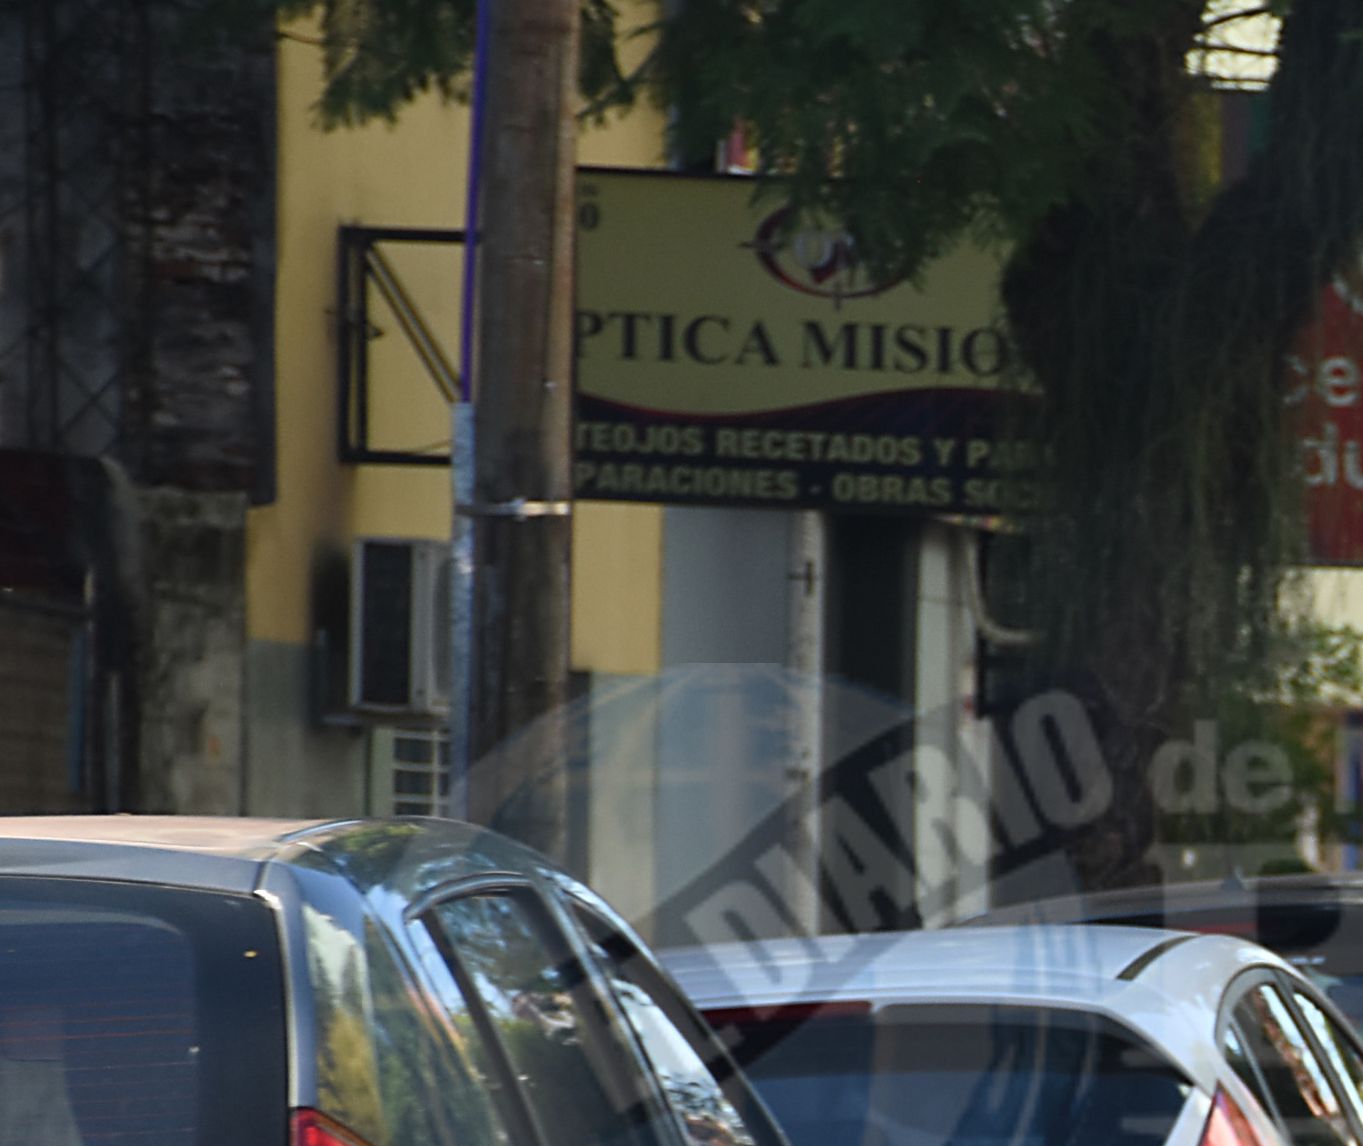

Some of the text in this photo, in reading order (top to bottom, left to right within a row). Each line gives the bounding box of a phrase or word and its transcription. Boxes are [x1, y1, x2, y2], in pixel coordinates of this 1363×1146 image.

[715, 429, 922, 467] RECETADOS
[932, 440, 955, 467] Y
[832, 474, 950, 506] OBRAS
